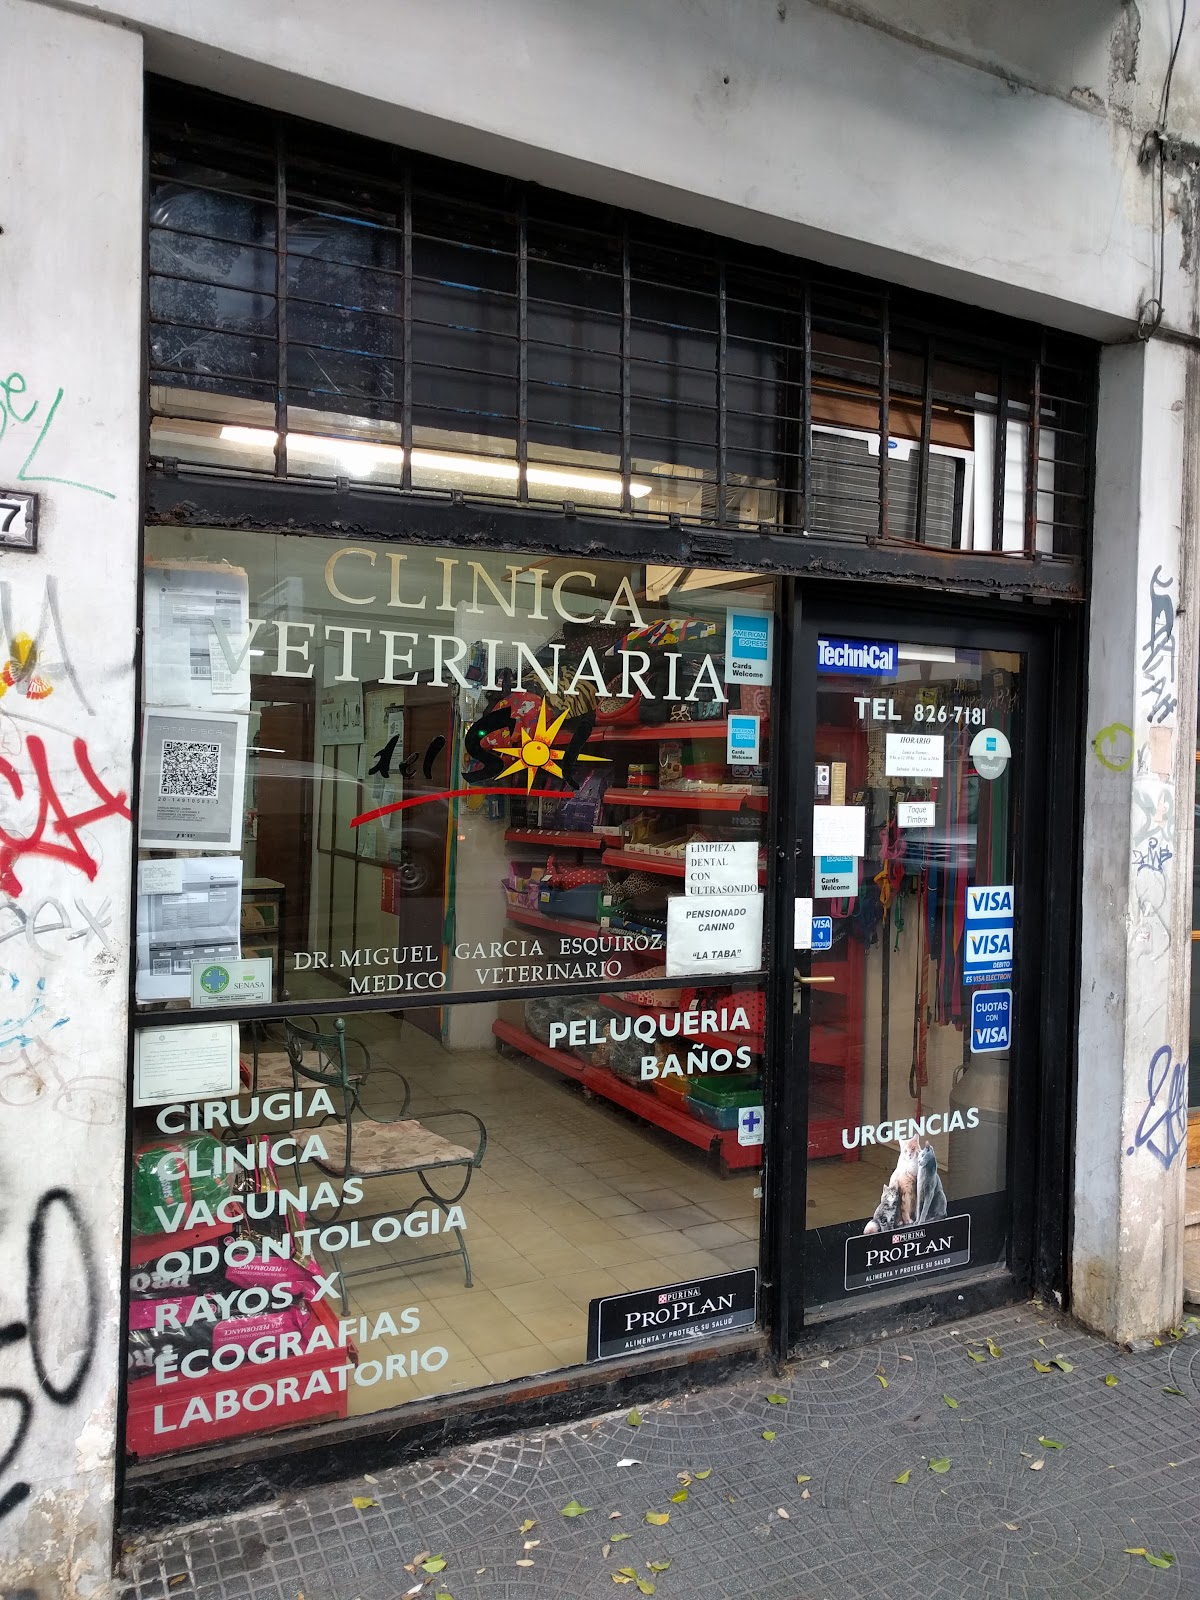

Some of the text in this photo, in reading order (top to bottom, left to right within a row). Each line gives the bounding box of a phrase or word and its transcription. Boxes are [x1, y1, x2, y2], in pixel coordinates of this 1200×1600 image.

[324, 547, 649, 629] CLINICA
[739, 639, 768, 648] EXPRESS
[206, 616, 729, 704] VETERINARIA
[732, 662, 752, 670] Cards
[732, 669, 764, 678] Welcome
[854, 697, 986, 726] TEL 826-7181
[900, 736, 931, 745] HORARIO
[906, 815, 928, 824] Timbre
[907, 805, 927, 815] Toque
[691, 858, 729, 867] DENTAL
[690, 872, 711, 881] CON
[690, 884, 757, 895] ULTRASONIDO
[969, 892, 1012, 912] VISA
[686, 908, 747, 919] PENSIONADO
[698, 922, 735, 932] CANINO
[813, 919, 831, 929] VISA
[293, 933, 664, 970] DR. MIGUEL GARCIA ESQUIROZ
[969, 934, 1011, 955] VISA
[233, 982, 265, 990] SENASA
[349, 960, 622, 995] MEDICO VETERINARIO
[976, 1001, 1008, 1012] CUOTAS
[549, 1007, 751, 1049] PELUQUERIA
[974, 1026, 1008, 1044] VISA
[641, 1043, 752, 1081] BAÑOS
[156, 1088, 336, 1134] CIRUGIA
[842, 1107, 980, 1149] URGENCIAS
[157, 1134, 330, 1182] CLINICA
[153, 1177, 364, 1234] VACUNAS
[156, 1205, 468, 1281] ODONTOLOGIA
[900, 1230, 925, 1242] PURINA
[866, 1270, 893, 1282] ALIMENTA
[900, 1265, 924, 1275] PROTEGE
[934, 1257, 951, 1267] SALUD
[154, 1272, 341, 1333] RAYOS X
[667, 1288, 699, 1302] PURINA
[625, 1335, 660, 1348] ALIMENTA
[661, 1332, 667, 1340] Y
[668, 1326, 700, 1339] PROTEGE
[711, 1316, 734, 1328] SALUD
[154, 1307, 421, 1387] ECOGRAFIAS
[154, 1346, 449, 1436] LABORATORIO
